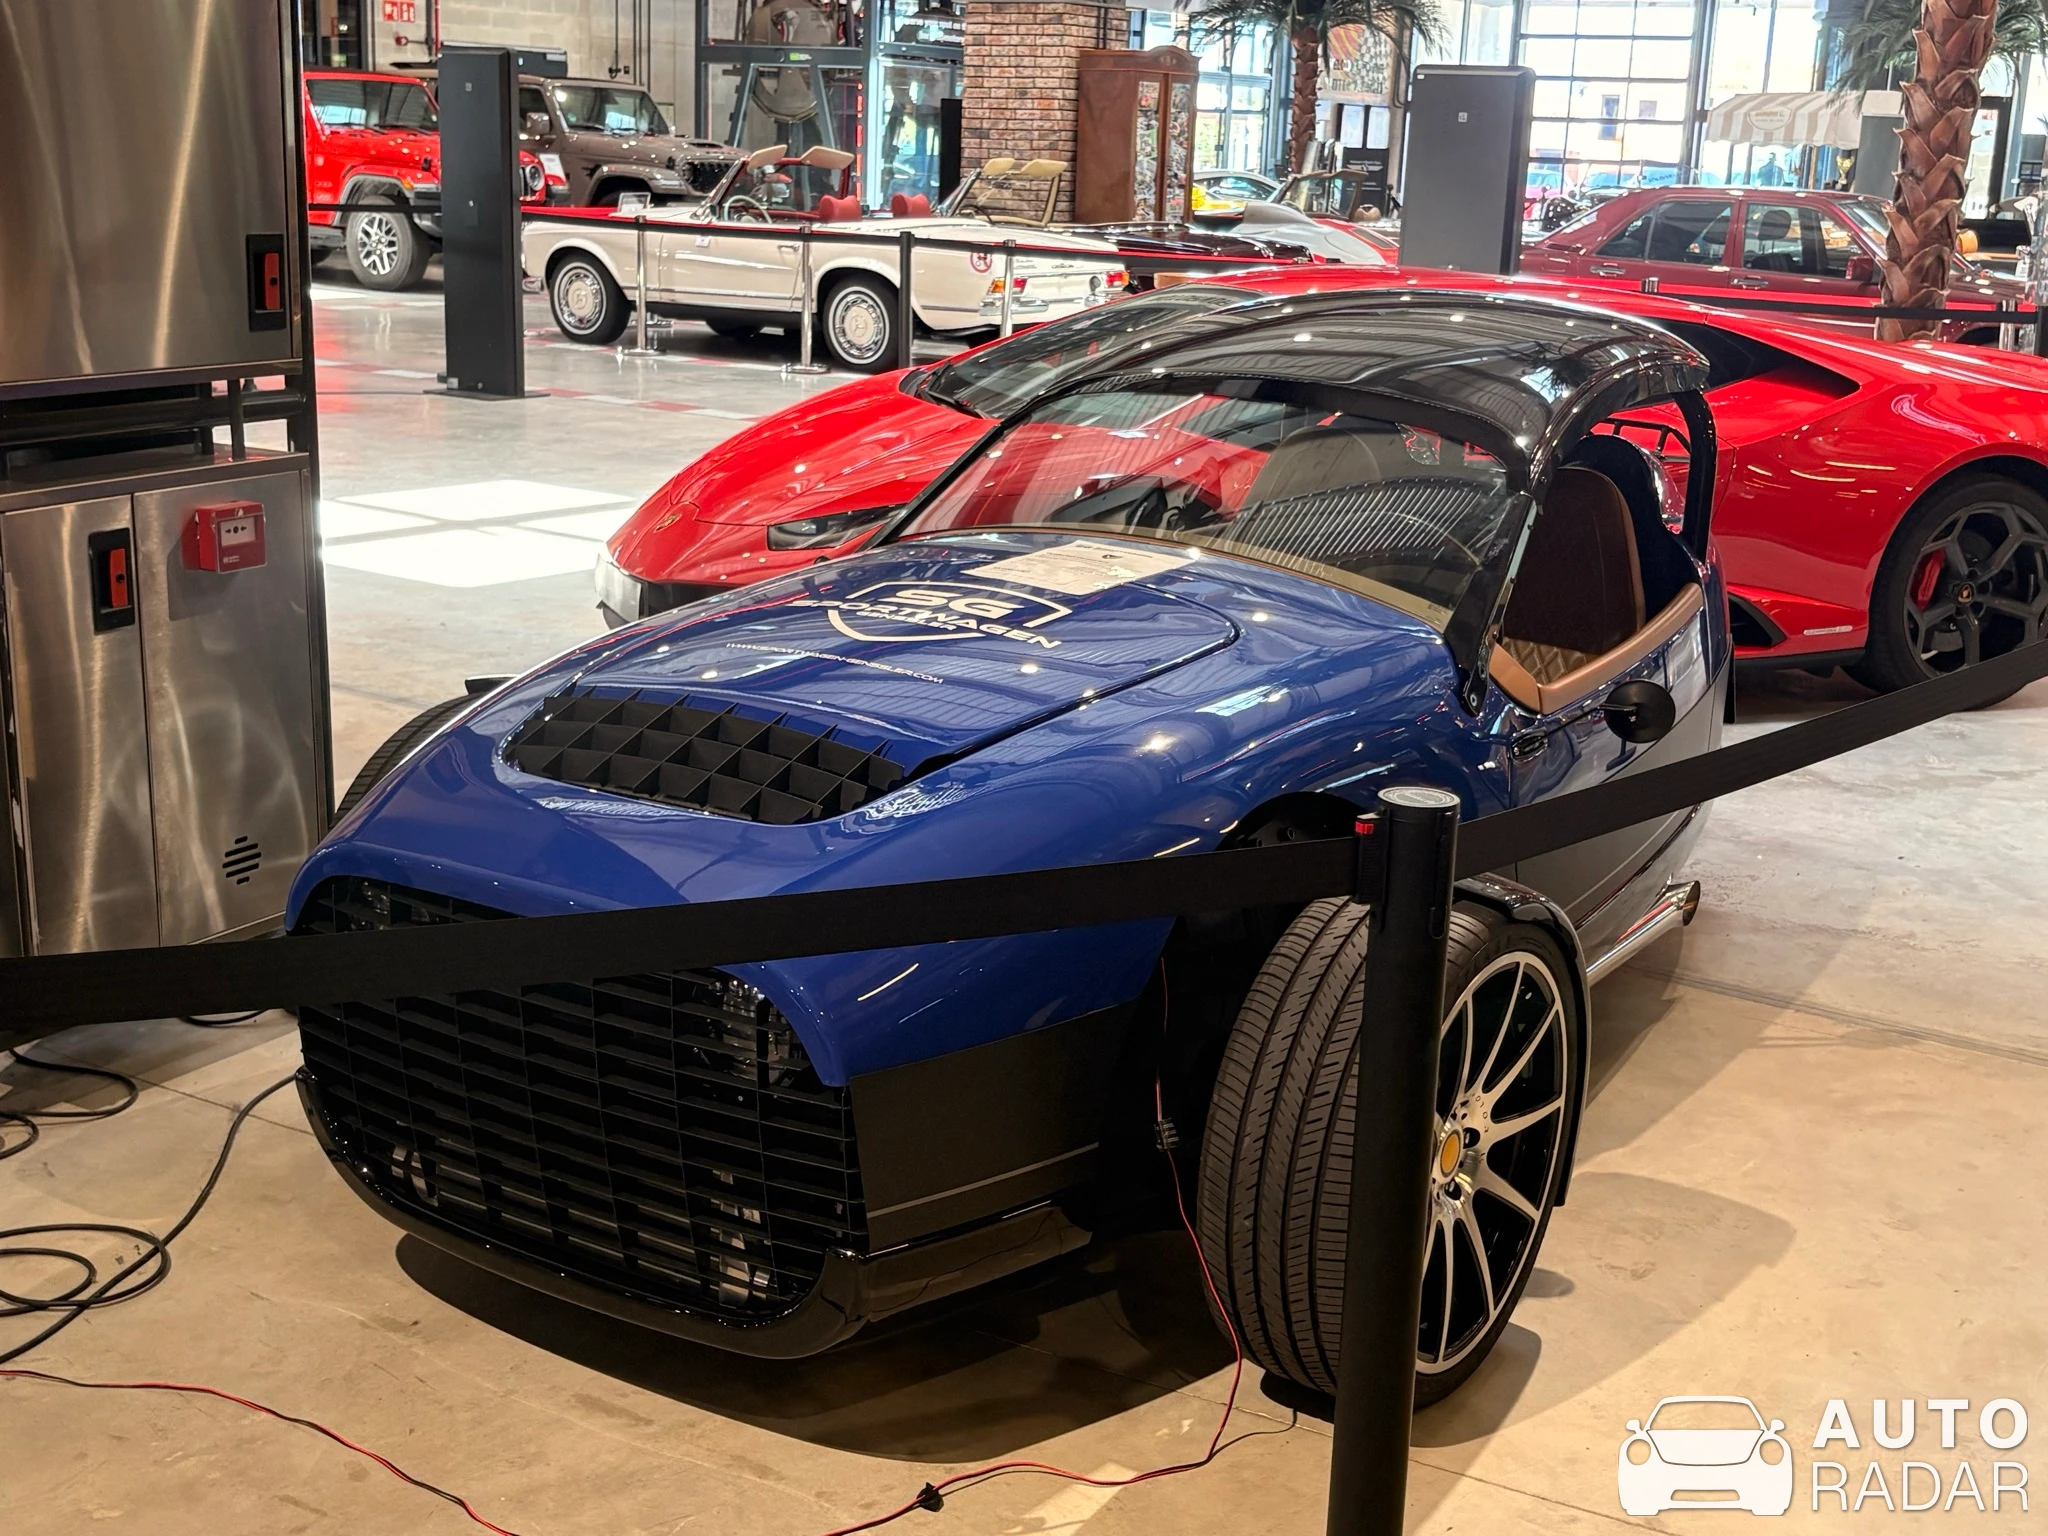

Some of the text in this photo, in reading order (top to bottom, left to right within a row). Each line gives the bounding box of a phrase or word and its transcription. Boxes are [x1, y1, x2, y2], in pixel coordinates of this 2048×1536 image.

[878, 589, 1025, 619] SG
[787, 600, 1061, 649] SPORTWAGEN
[856, 611, 957, 631] GENSSLER
